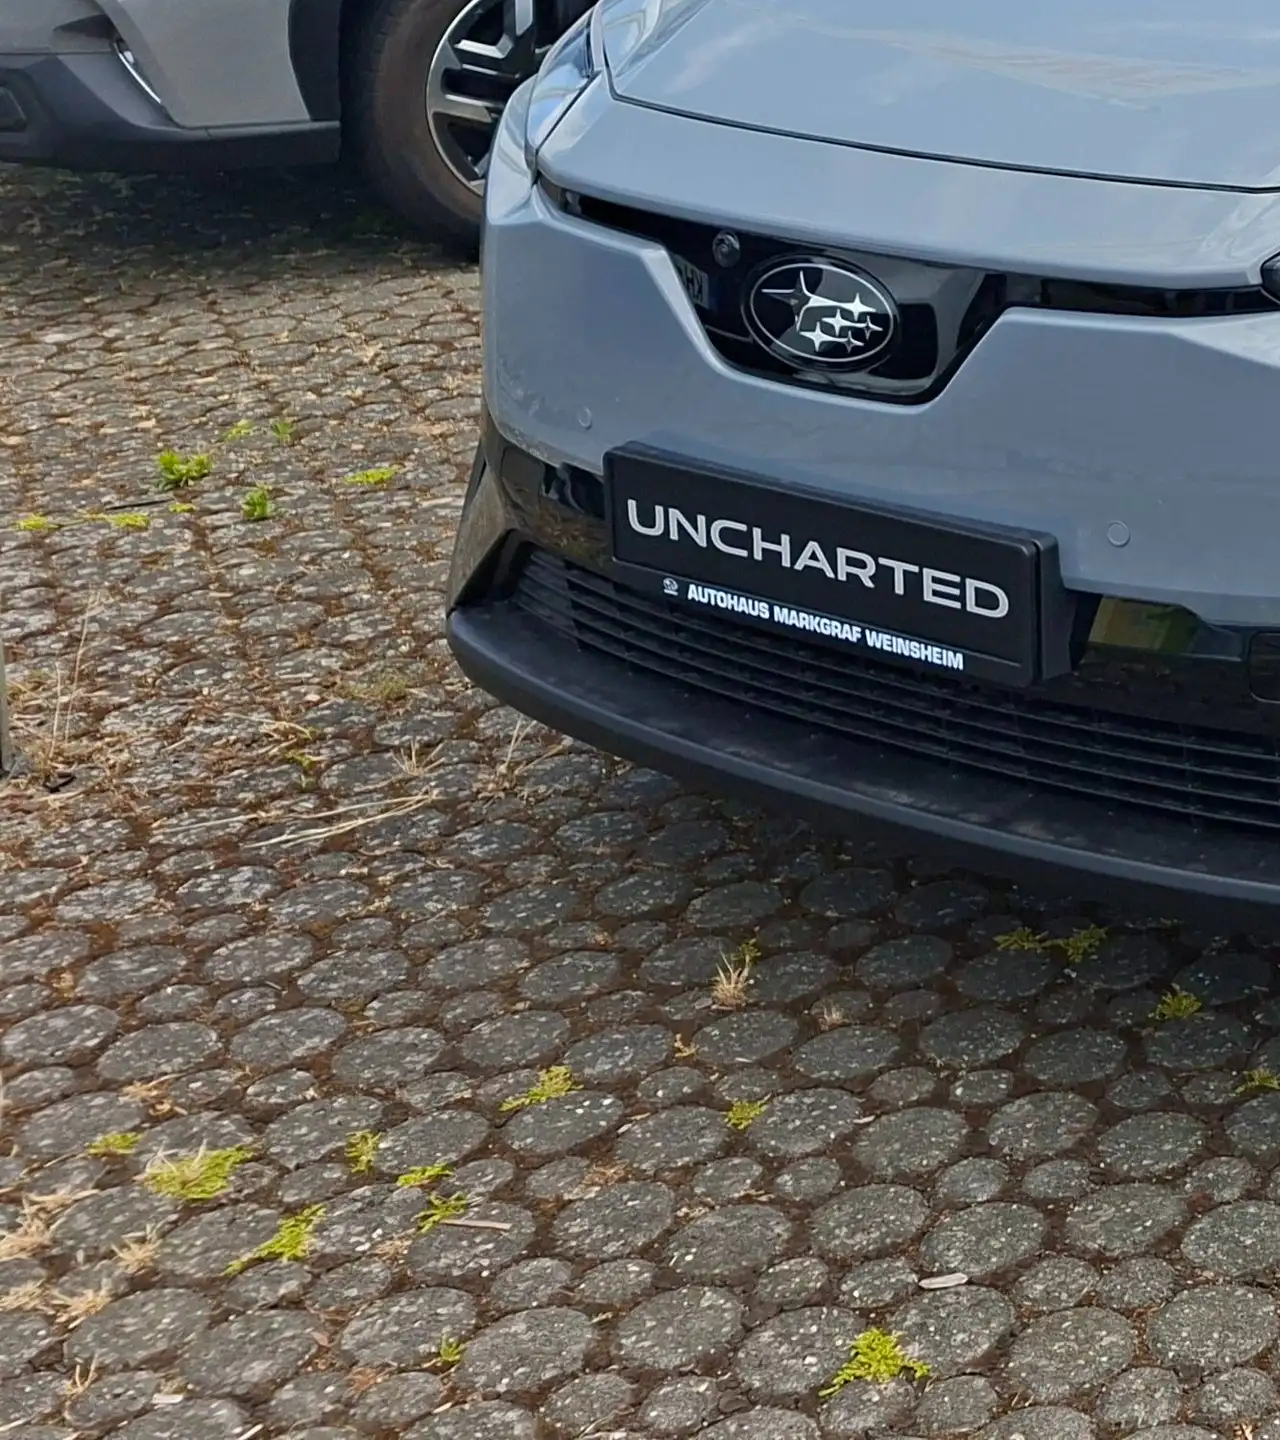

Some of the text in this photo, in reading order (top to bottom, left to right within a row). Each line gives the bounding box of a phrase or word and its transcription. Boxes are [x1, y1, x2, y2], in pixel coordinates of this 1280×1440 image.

[627, 499, 1010, 619] UNCHARTED
[687, 584, 964, 671] AUTOHAUS MARKGRAF WEINSHEIM
